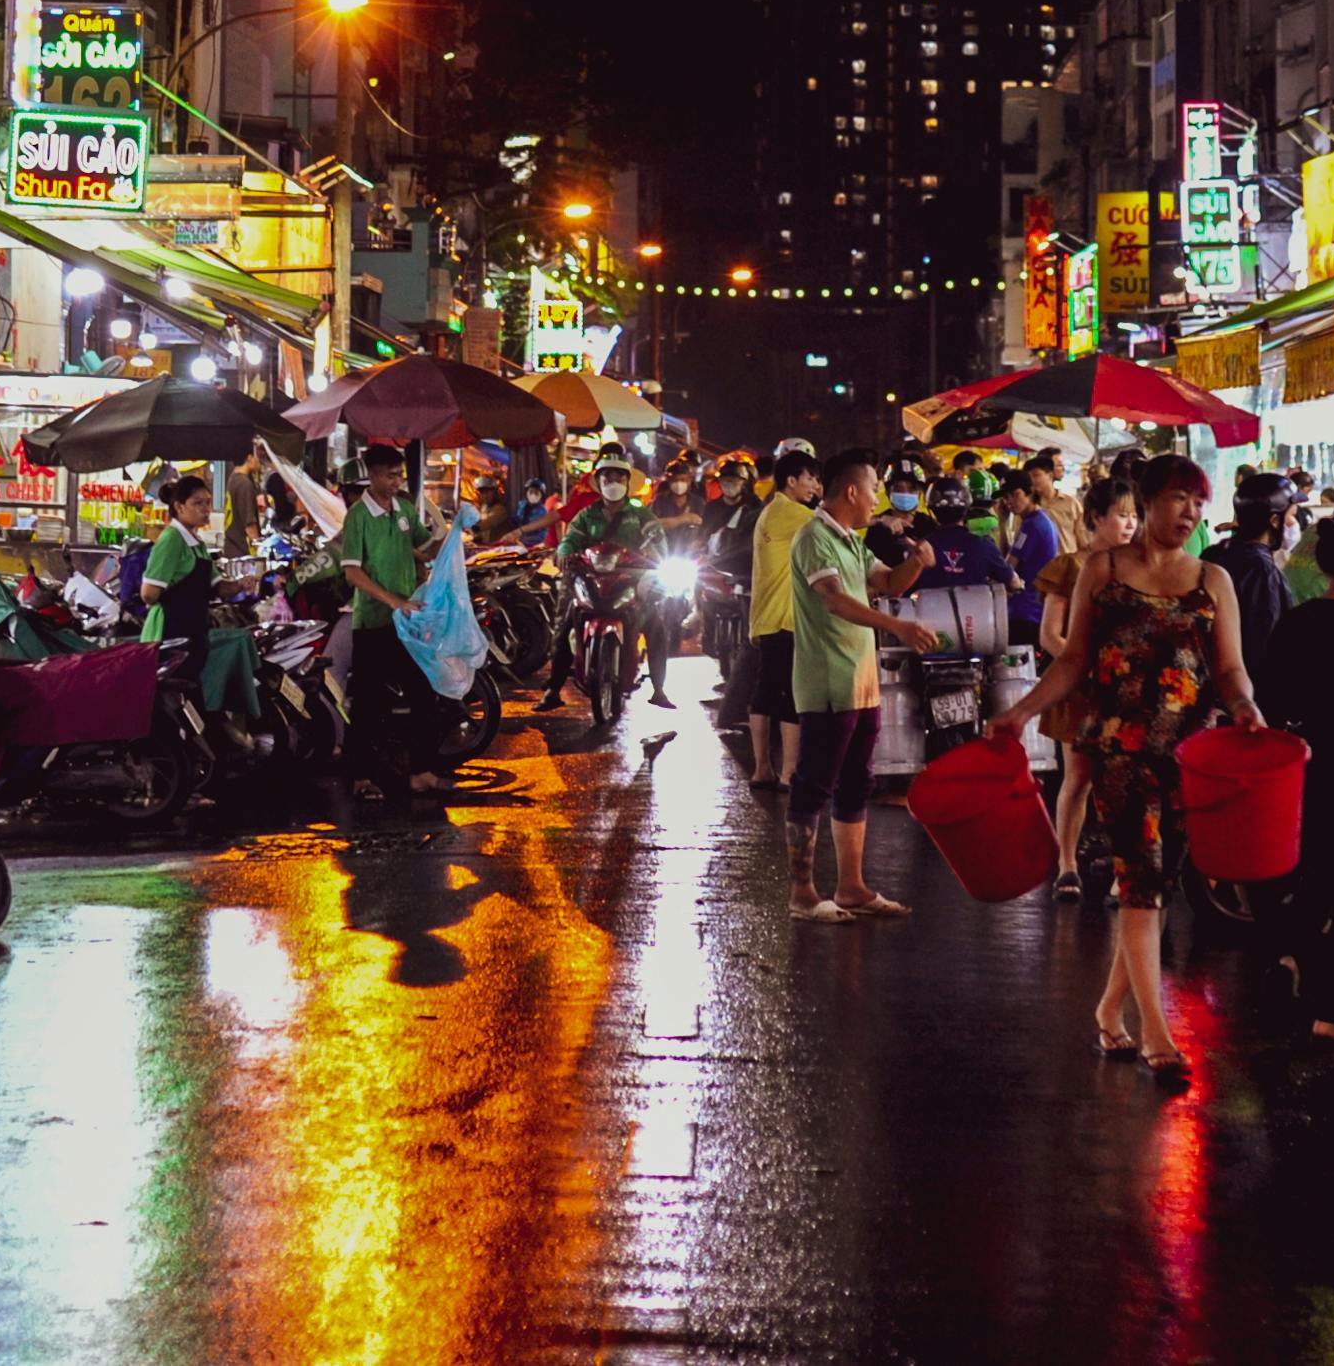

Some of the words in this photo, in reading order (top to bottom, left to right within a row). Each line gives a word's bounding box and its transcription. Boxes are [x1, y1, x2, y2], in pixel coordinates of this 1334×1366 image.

[63, 14, 116, 33] Quán
[42, 32, 82, 68] SỦI
[85, 32, 137, 68] CẢO
[17, 120, 70, 172] SỦI
[76, 124, 138, 175] CẢO
[16, 173, 71, 198] Shun
[77, 176, 106, 200] Fa
[1189, 186, 1229, 215] SỦI
[1110, 270, 1147, 294] SỦI
